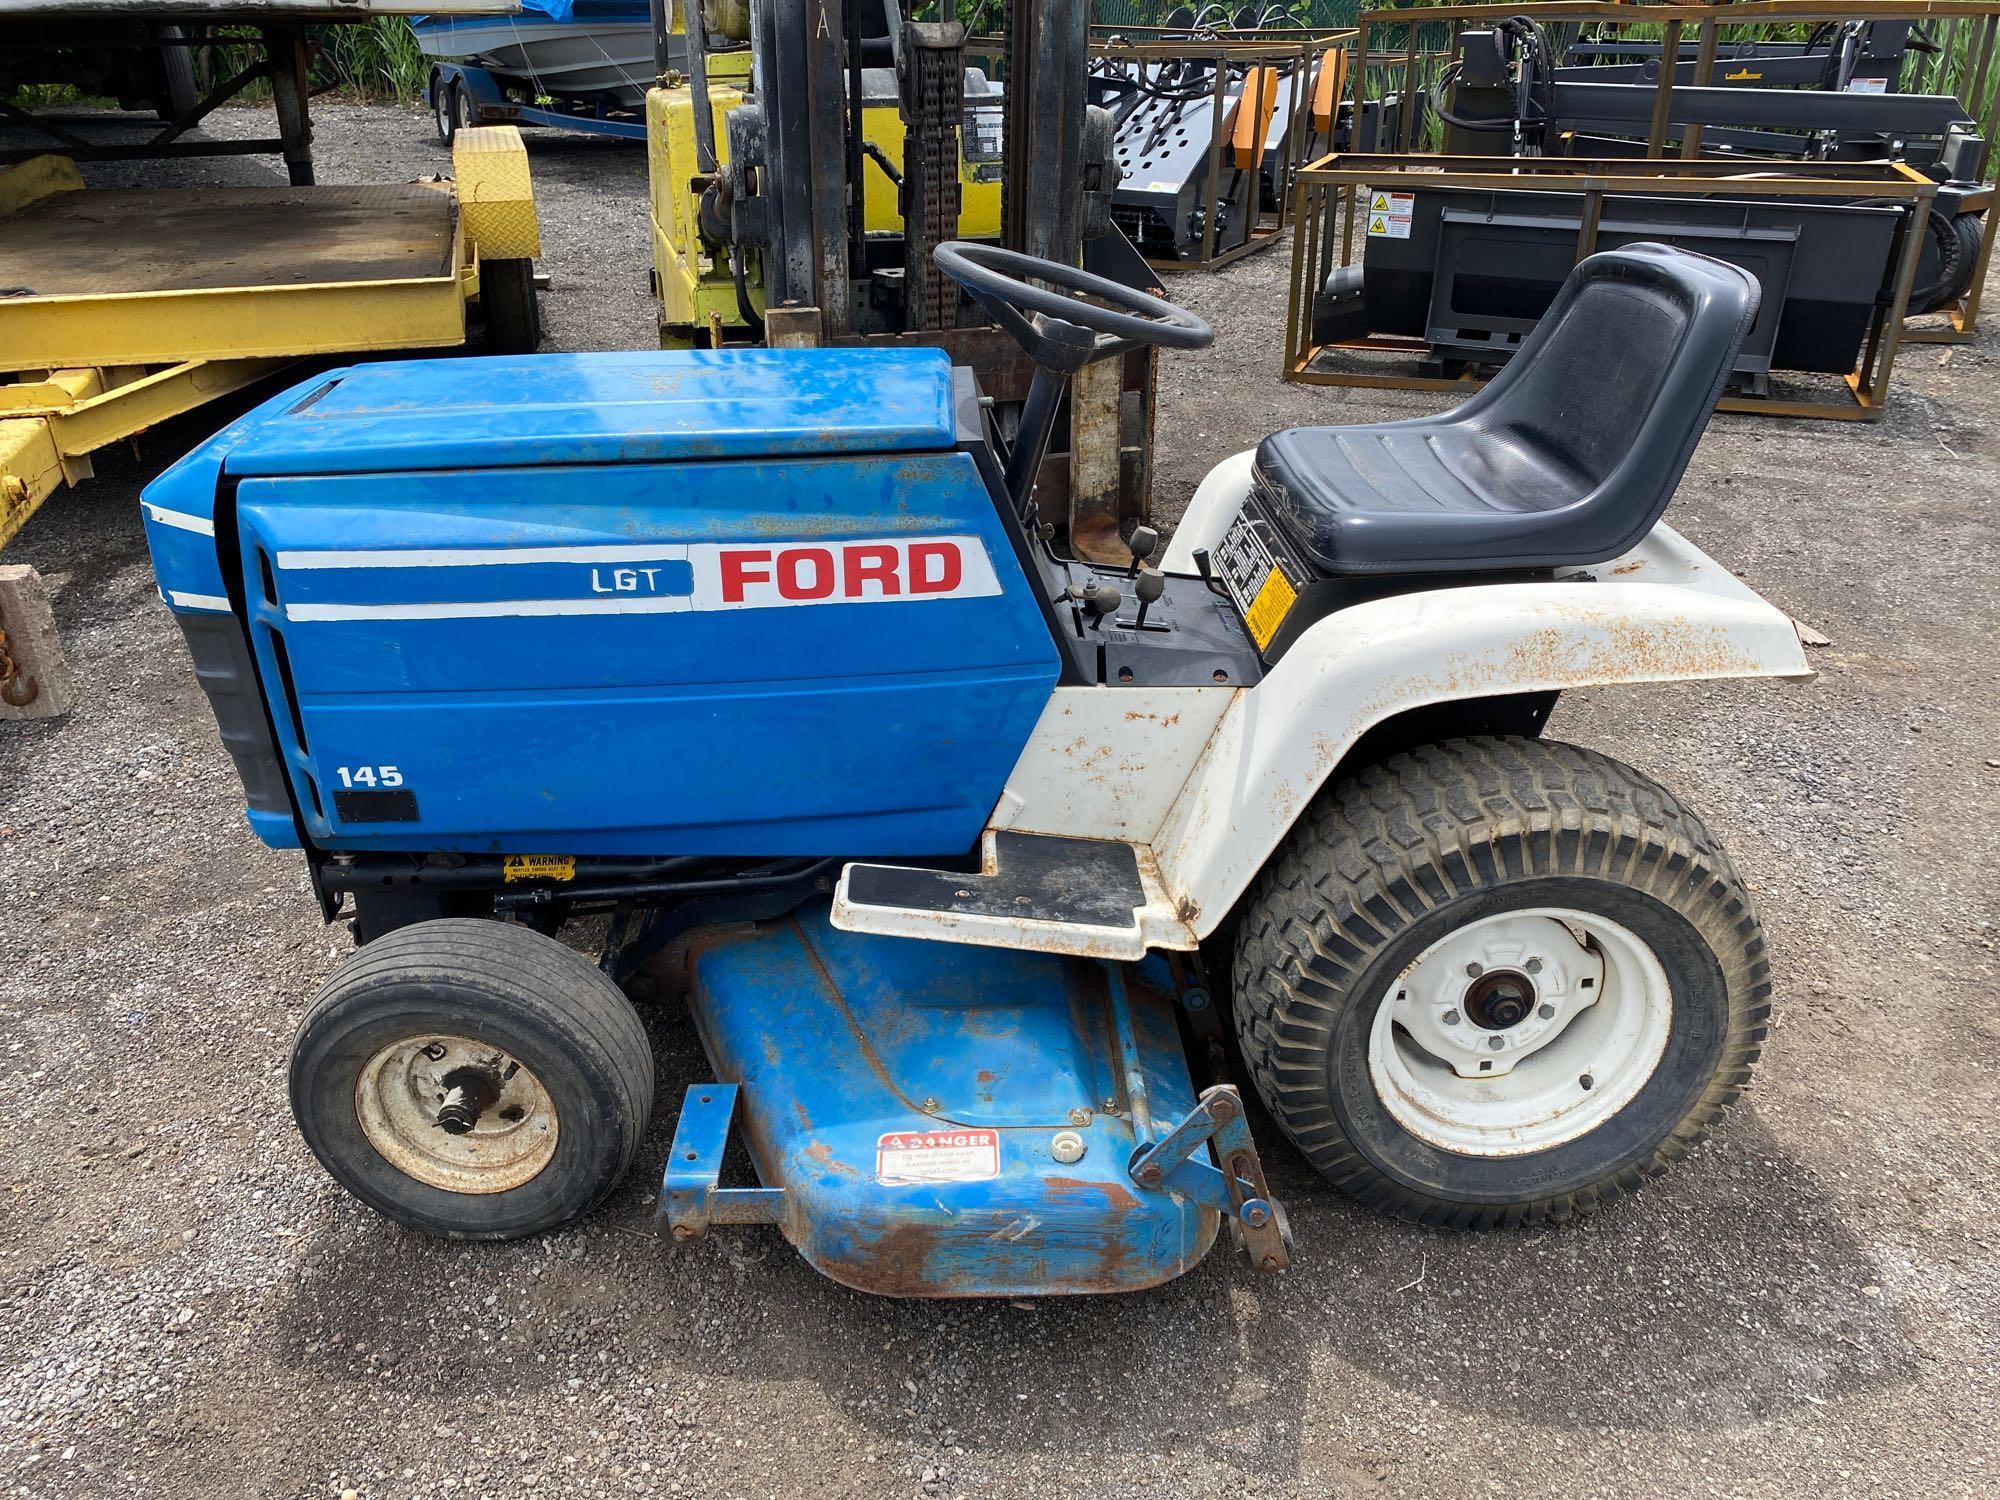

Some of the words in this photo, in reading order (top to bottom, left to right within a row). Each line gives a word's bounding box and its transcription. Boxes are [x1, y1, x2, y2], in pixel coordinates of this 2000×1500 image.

[592, 568, 662, 592] LGT
[719, 542, 962, 603] FORD
[336, 765, 404, 788] 145
[529, 856, 570, 866] WARNING
[909, 1135, 990, 1149] DANGER
